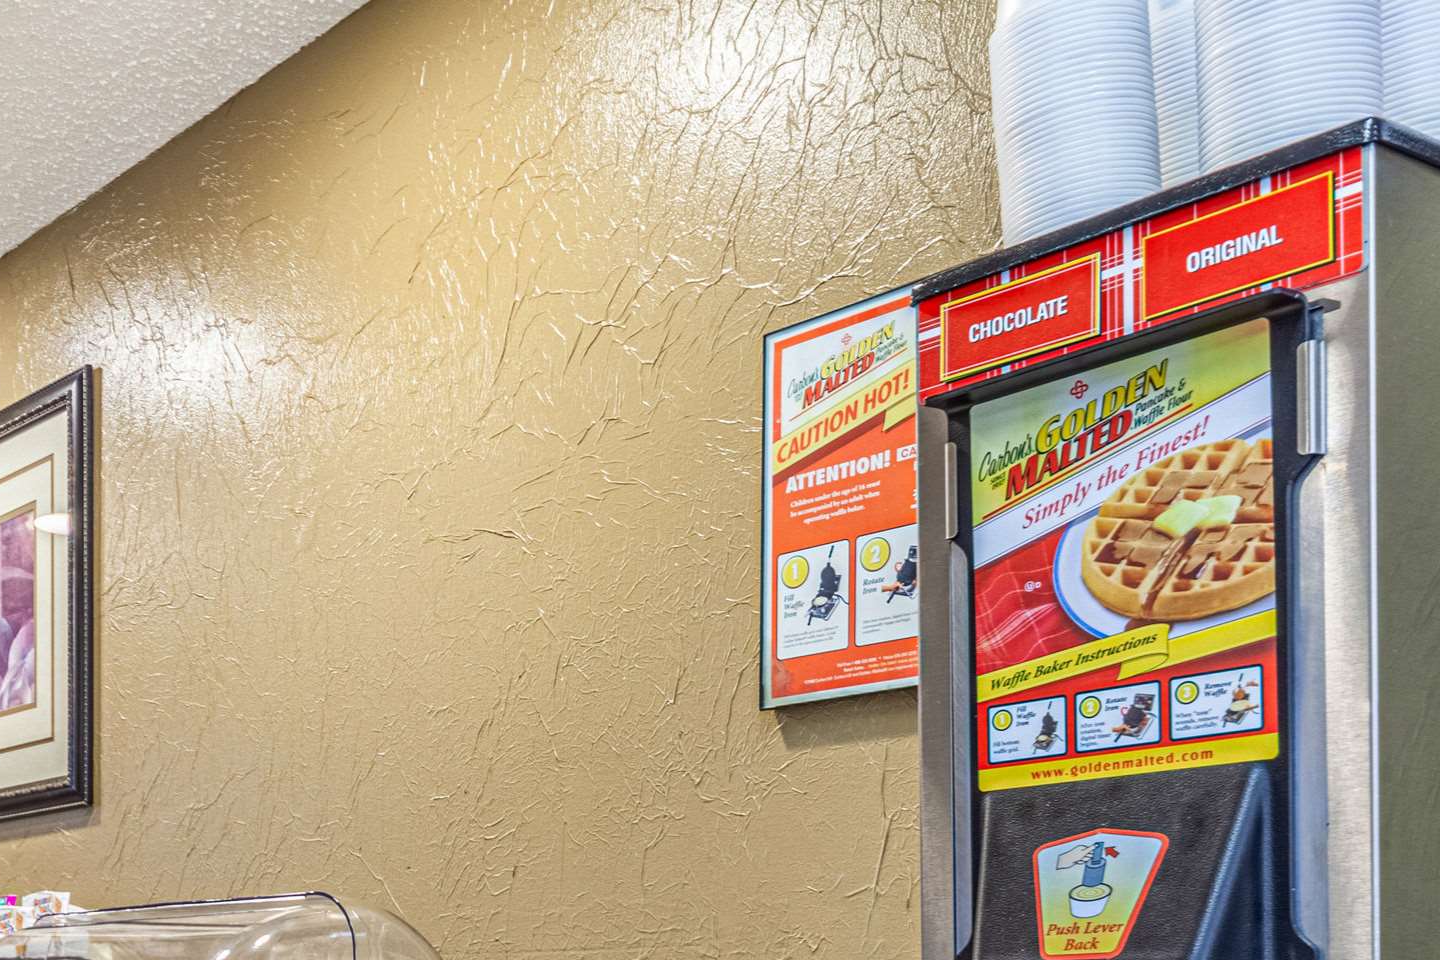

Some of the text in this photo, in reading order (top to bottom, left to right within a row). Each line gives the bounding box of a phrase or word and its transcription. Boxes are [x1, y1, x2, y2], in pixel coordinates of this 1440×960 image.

[1186, 225, 1283, 273] ORIGINAL
[968, 295, 1068, 343] CHOCOLATE
[803, 352, 875, 409] MALTED
[1135, 386, 1176, 415] Pancake
[777, 368, 909, 463] CAUTION HOT!
[978, 358, 1168, 482] Carbon's GOLDEN
[1134, 390, 1193, 428] Waffle Flour
[785, 449, 890, 493] ATTENTION!
[1006, 410, 1133, 501] MALTED
[1022, 415, 1210, 529] Simply the Finest!
[791, 564, 799, 580] 1
[871, 545, 881, 563] 2
[991, 633, 1157, 692] Waffle Baker Instructions
[1031, 750, 1213, 780] www.goldenmalted.com
[1047, 921, 1124, 936] Push Lever
[1064, 937, 1100, 951] Back
